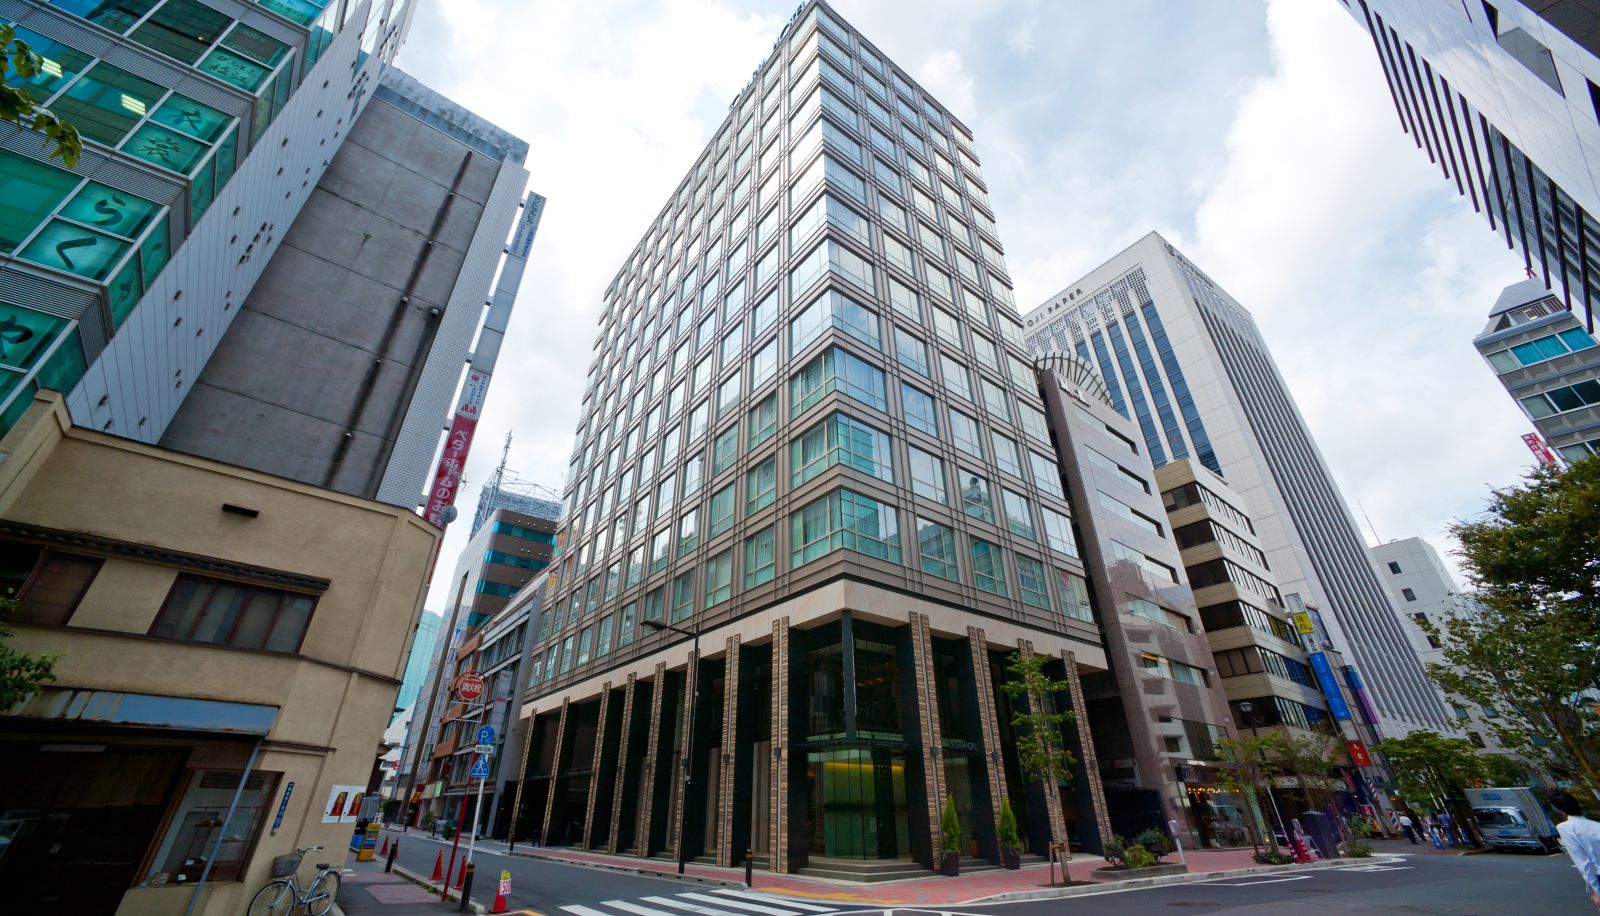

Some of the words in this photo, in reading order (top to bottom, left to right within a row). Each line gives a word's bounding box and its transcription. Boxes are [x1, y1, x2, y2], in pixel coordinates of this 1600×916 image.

[1027, 312, 1044, 327] OJI
[1047, 288, 1084, 315] PAPER
[461, 682, 483, 694] 消火栓
[480, 730, 489, 743] P
